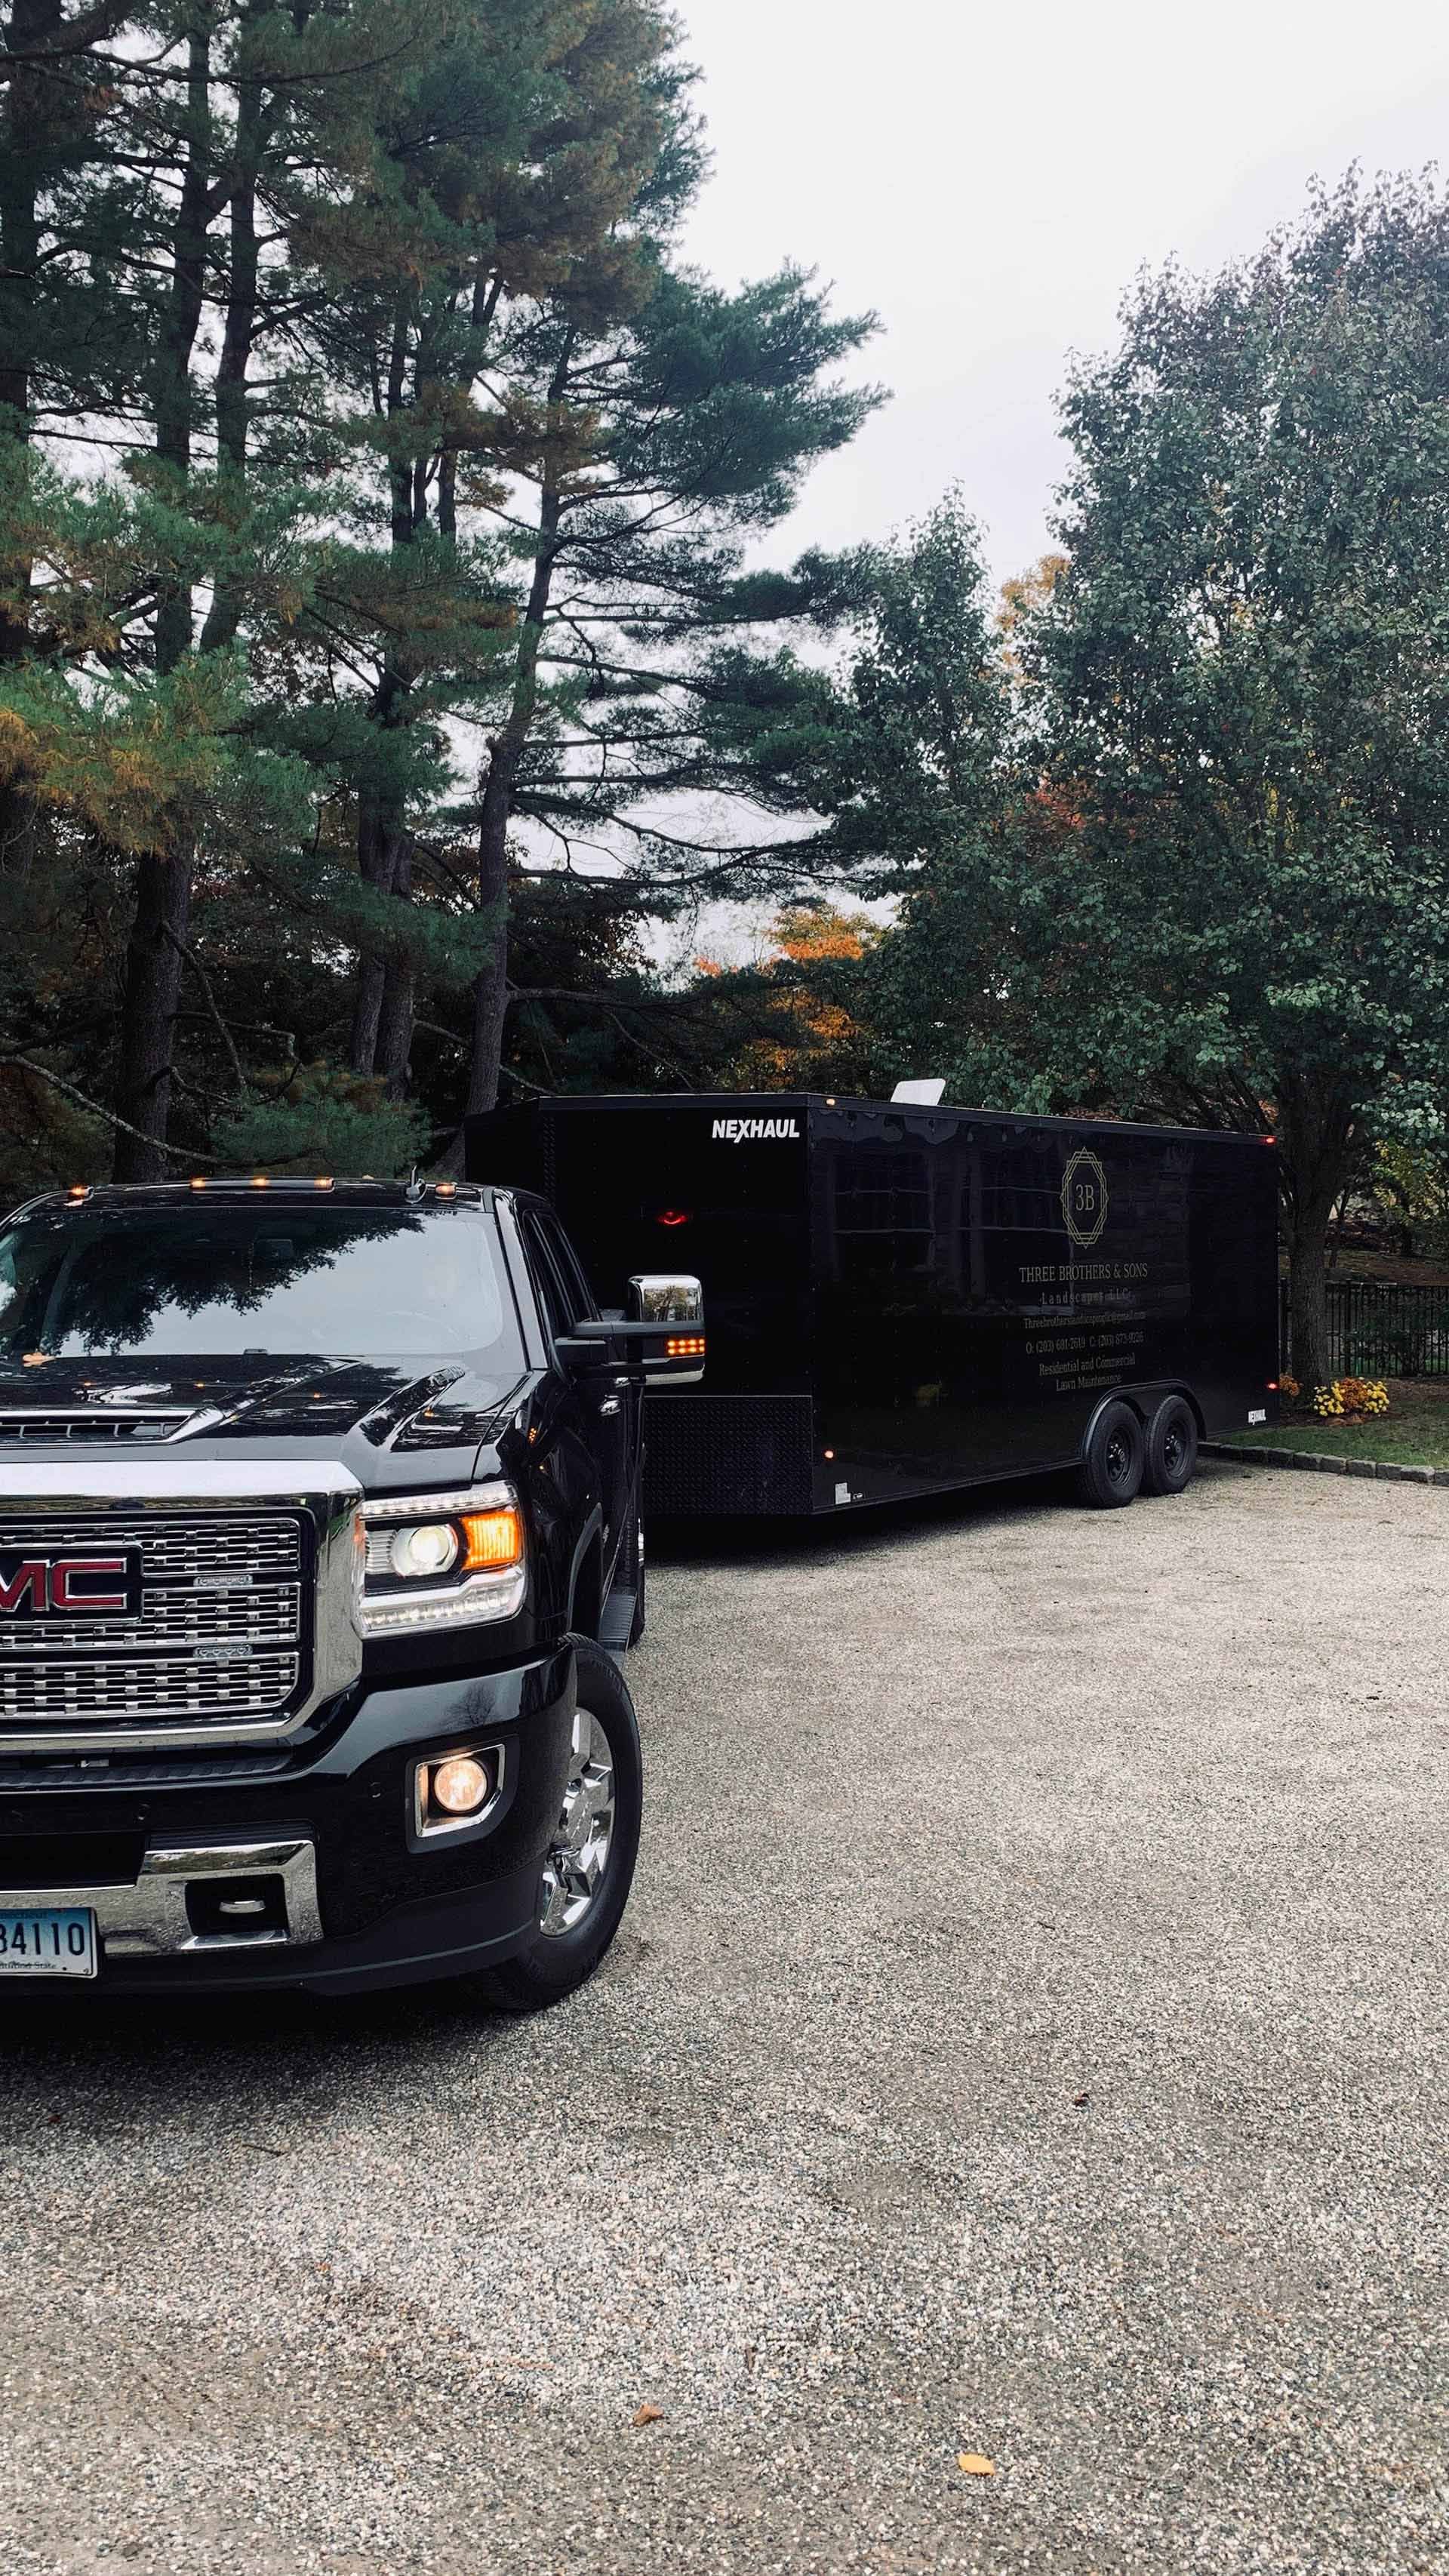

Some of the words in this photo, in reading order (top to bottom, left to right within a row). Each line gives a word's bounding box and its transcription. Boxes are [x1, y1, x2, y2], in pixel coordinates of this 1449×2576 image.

[712, 1119, 800, 1143] NEXHAUL
[1075, 1184, 1095, 1211] 3B
[1019, 1266, 1056, 1282] THREE
[1059, 1263, 1111, 1281] BROTHERS
[1113, 1263, 1121, 1279] &
[1124, 1262, 1148, 1278] SONS
[1035, 1340, 1054, 1353] (203)
[1039, 1358, 1079, 1376] Residential
[1081, 1357, 1094, 1371] and
[1095, 1352, 1136, 1368] Commercial
[1057, 1379, 1076, 1392] Lawn
[1078, 1374, 1122, 1388] Maintenance
